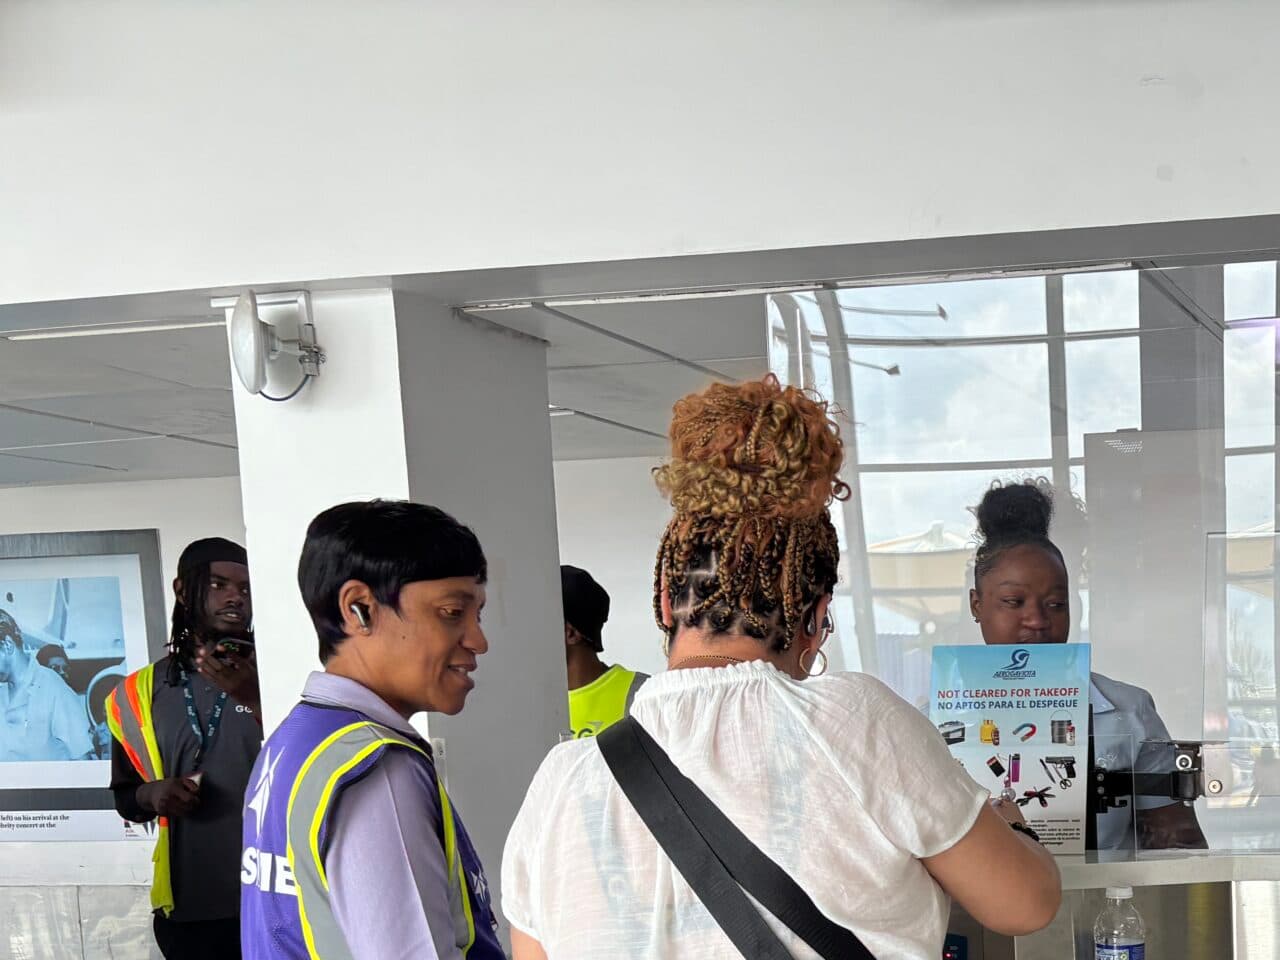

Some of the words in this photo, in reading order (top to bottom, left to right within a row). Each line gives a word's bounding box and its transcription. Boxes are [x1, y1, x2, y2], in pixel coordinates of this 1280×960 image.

[937, 690, 960, 699] NOT
[963, 688, 1007, 698] CLEARED
[1010, 688, 1031, 698] FOR
[1034, 687, 1079, 697] TAKEOFF
[938, 701, 953, 710] NO
[955, 700, 986, 710] APTOS
[988, 700, 1014, 709] PARA
[1016, 700, 1027, 709] EL
[1029, 699, 1078, 709] DESPEGUE
[59, 813, 70, 821] the
